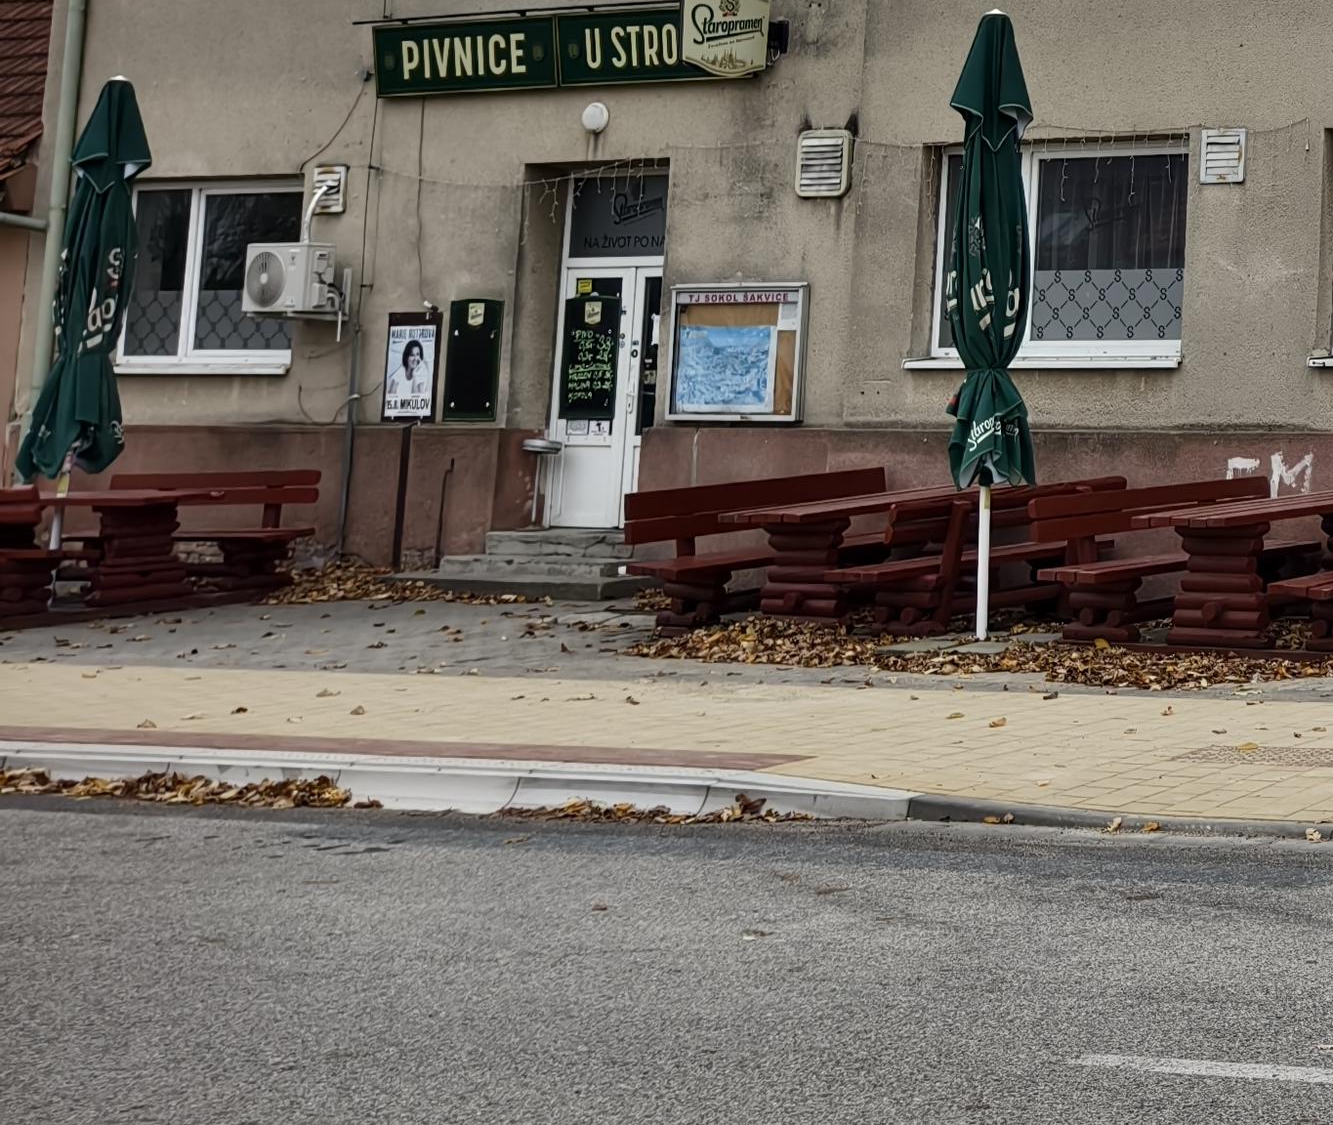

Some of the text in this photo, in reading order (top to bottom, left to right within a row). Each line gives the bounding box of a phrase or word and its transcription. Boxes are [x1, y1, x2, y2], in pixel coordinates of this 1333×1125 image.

[691, 3, 765, 45] Staropramen
[401, 22, 679, 81] PIVNICE U STRO
[601, 230, 632, 249] ŽIVOT
[634, 235, 649, 248] PO
[688, 291, 789, 303] TJ SOKOL ŠAKVICE
